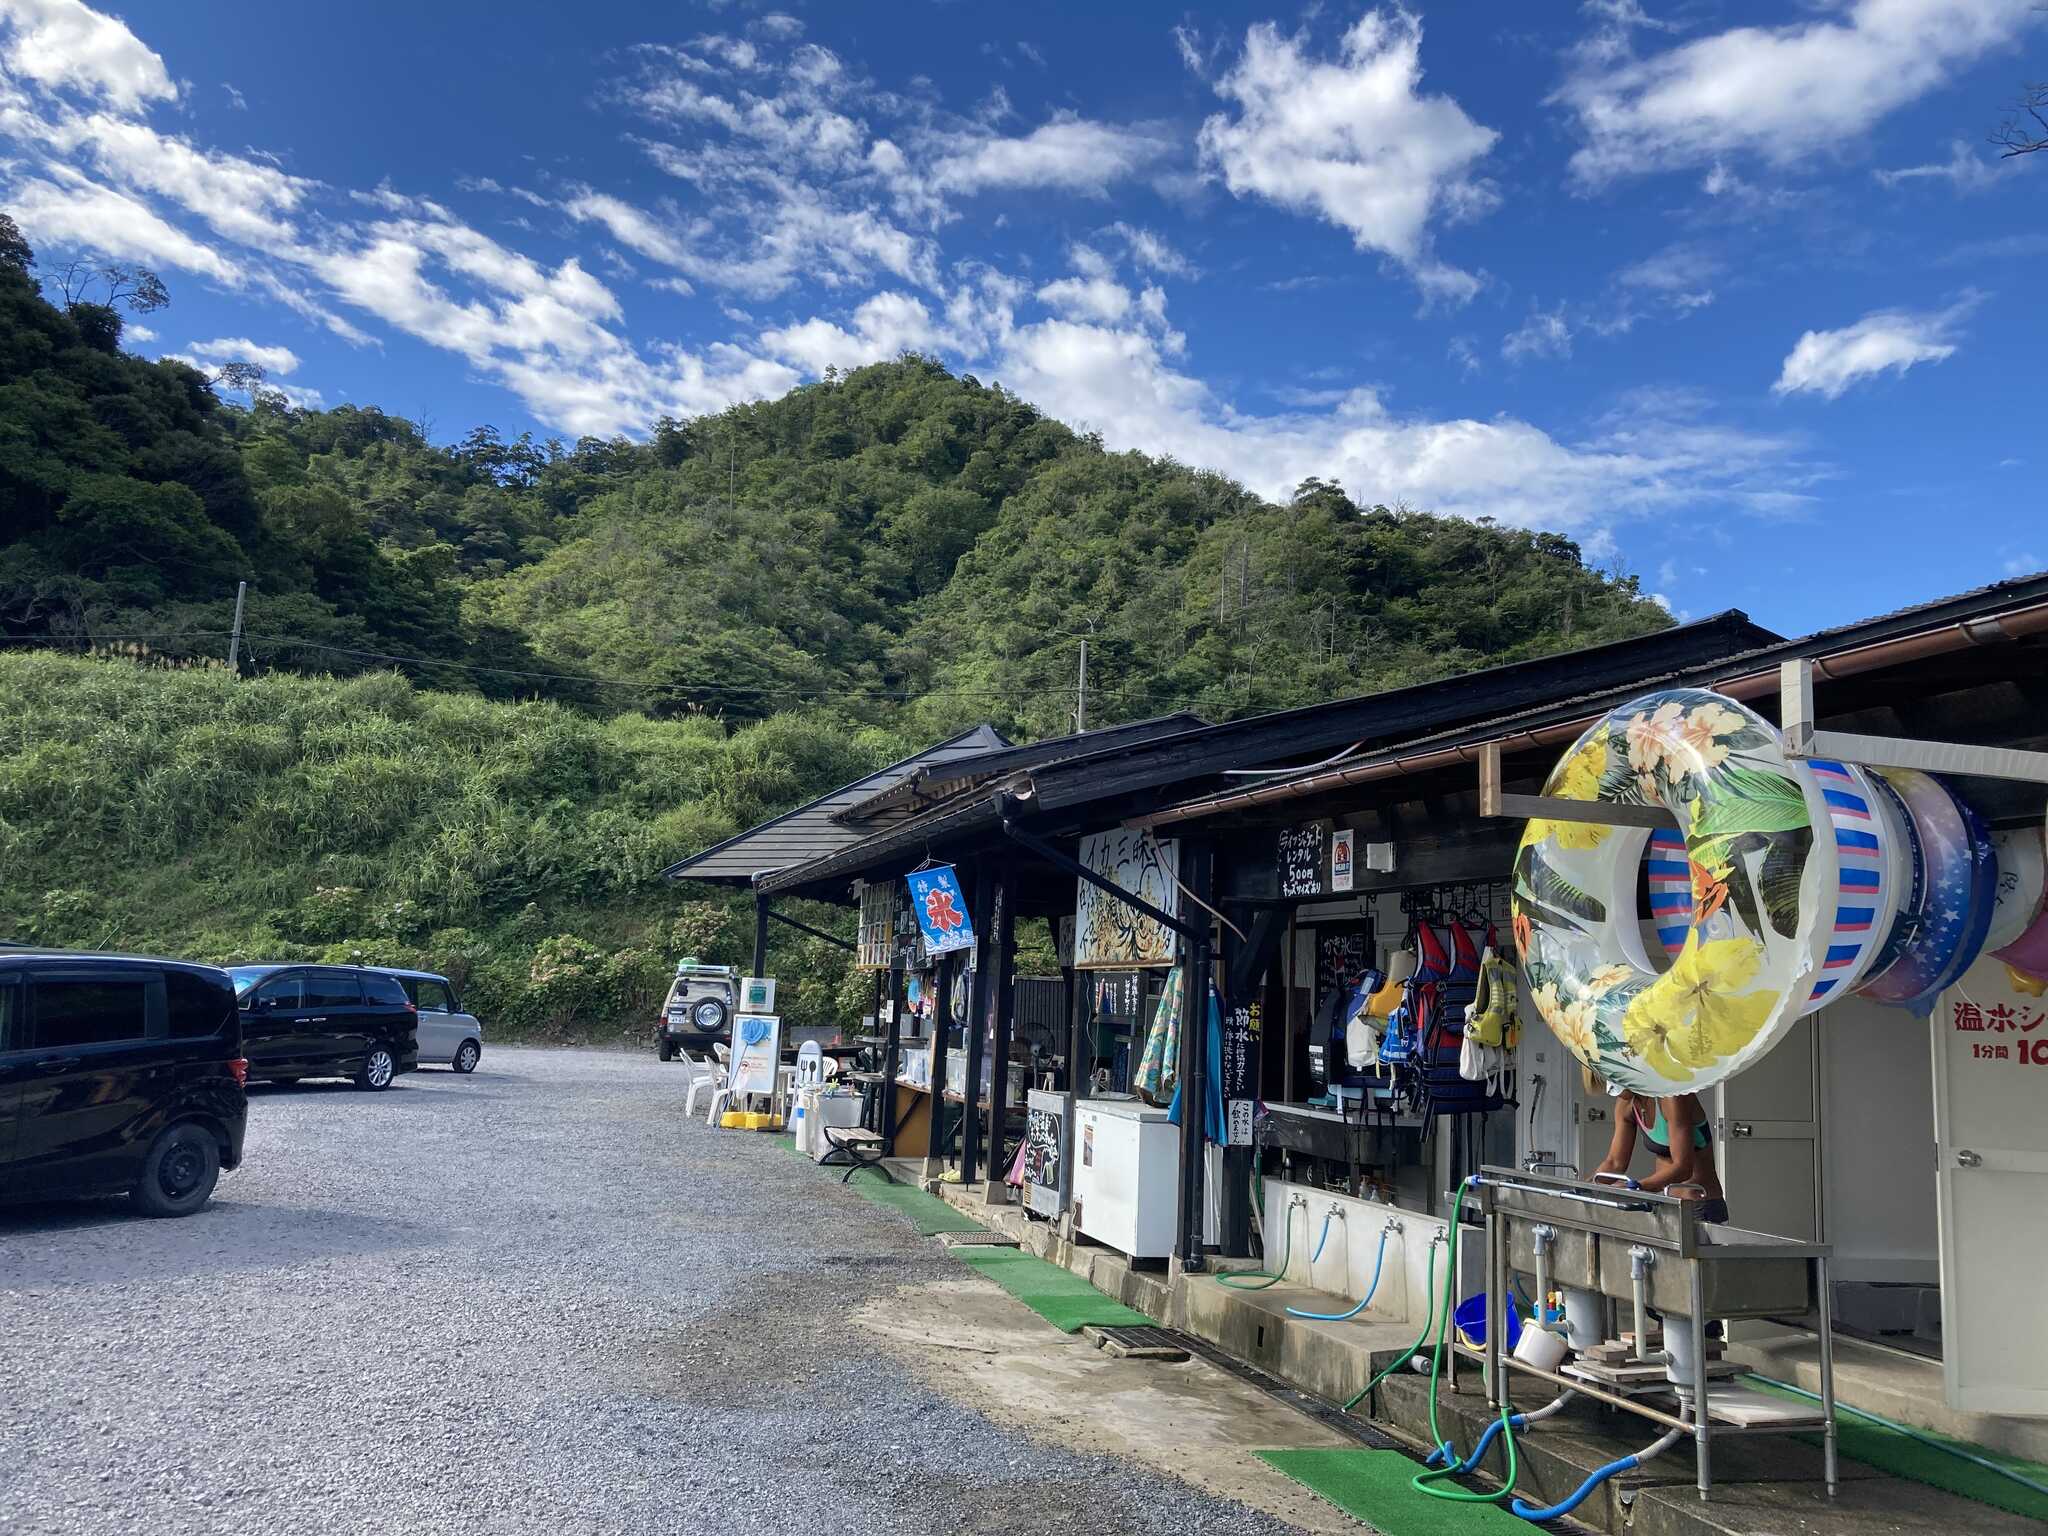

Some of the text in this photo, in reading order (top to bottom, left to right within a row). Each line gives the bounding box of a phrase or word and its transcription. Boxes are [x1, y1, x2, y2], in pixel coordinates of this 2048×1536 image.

[1286, 848, 1311, 864] レンタル
[1289, 865, 1313, 881] 500円
[926, 888, 964, 932] 氷
[1249, 1002, 1260, 1042] お願い
[1953, 1002, 2048, 1033] 温水シ
[1973, 1043, 2009, 1060] 1分間
